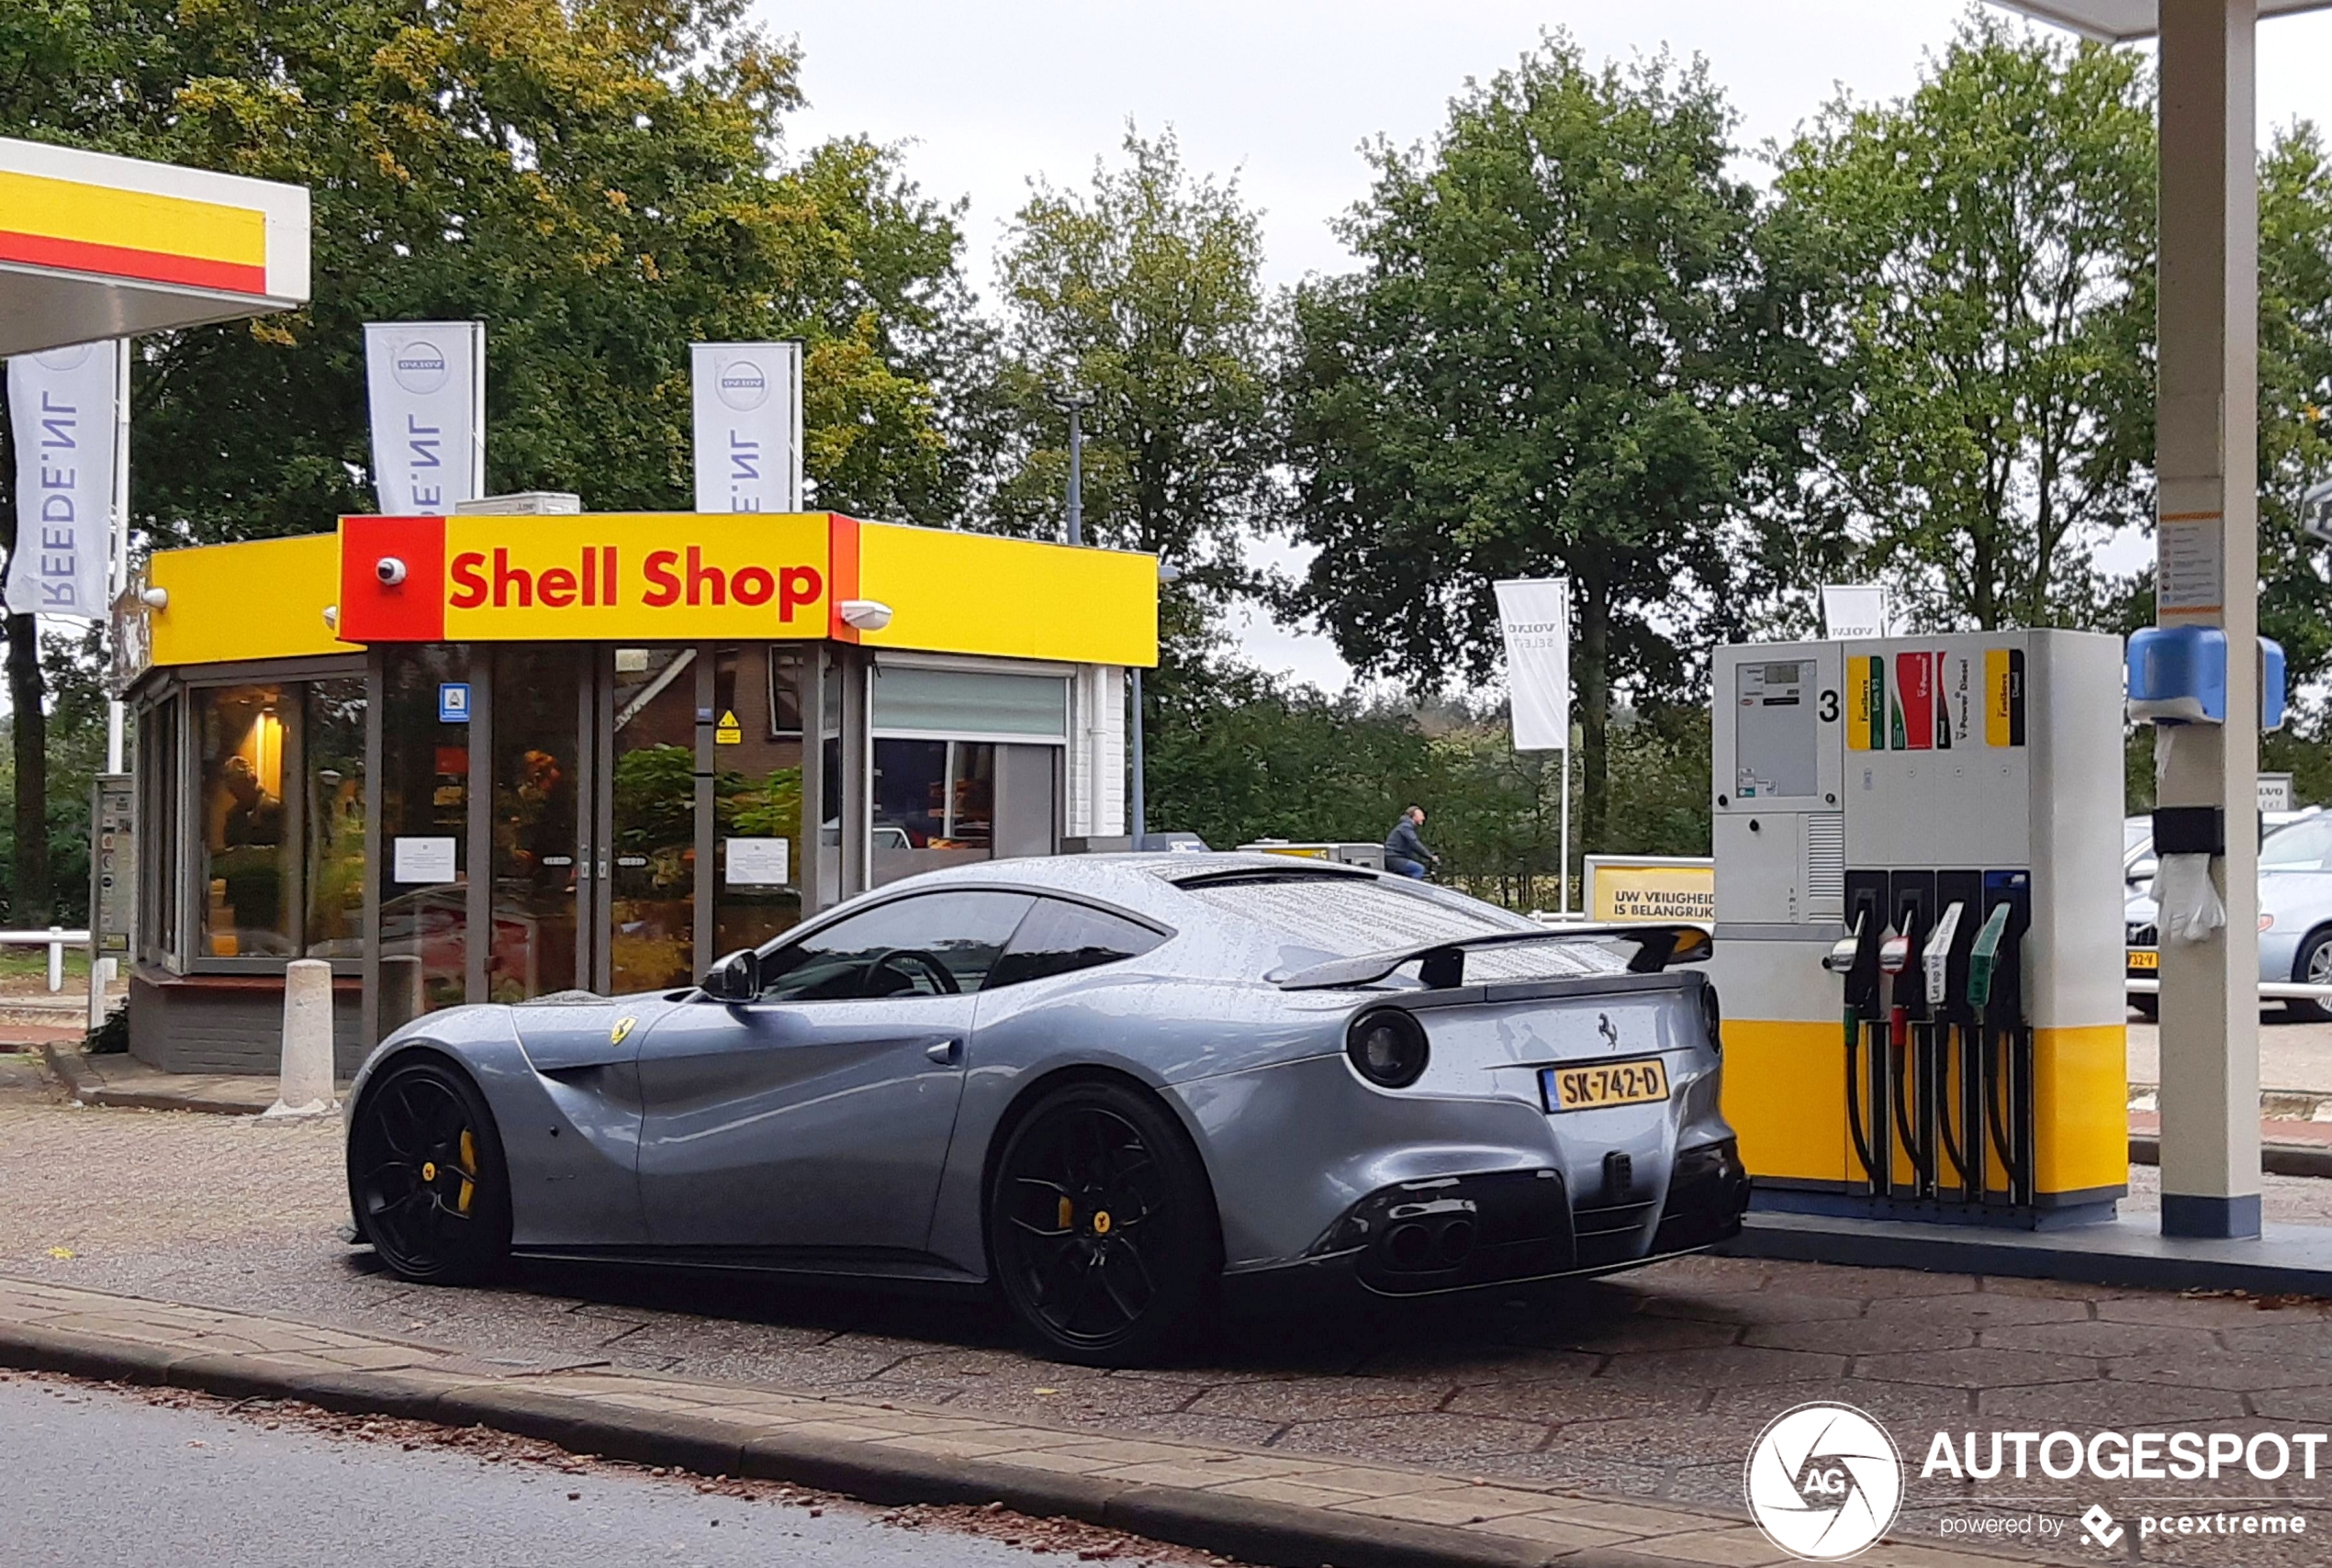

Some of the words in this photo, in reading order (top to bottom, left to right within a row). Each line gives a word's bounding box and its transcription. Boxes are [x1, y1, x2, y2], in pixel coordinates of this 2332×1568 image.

[449, 545, 618, 609] Shell
[641, 545, 824, 623] Shop
[1958, 659, 1968, 690] Diesel
[1819, 689, 1839, 722] 3
[1958, 695, 1968, 740] V-Power
[1614, 903, 1626, 915] IS
[1631, 905, 1714, 918] BELANGRIJK
[1615, 890, 1641, 902] UW
[1931, 984, 1940, 1000] Let
[1563, 1067, 1659, 1103] SK-742-D
